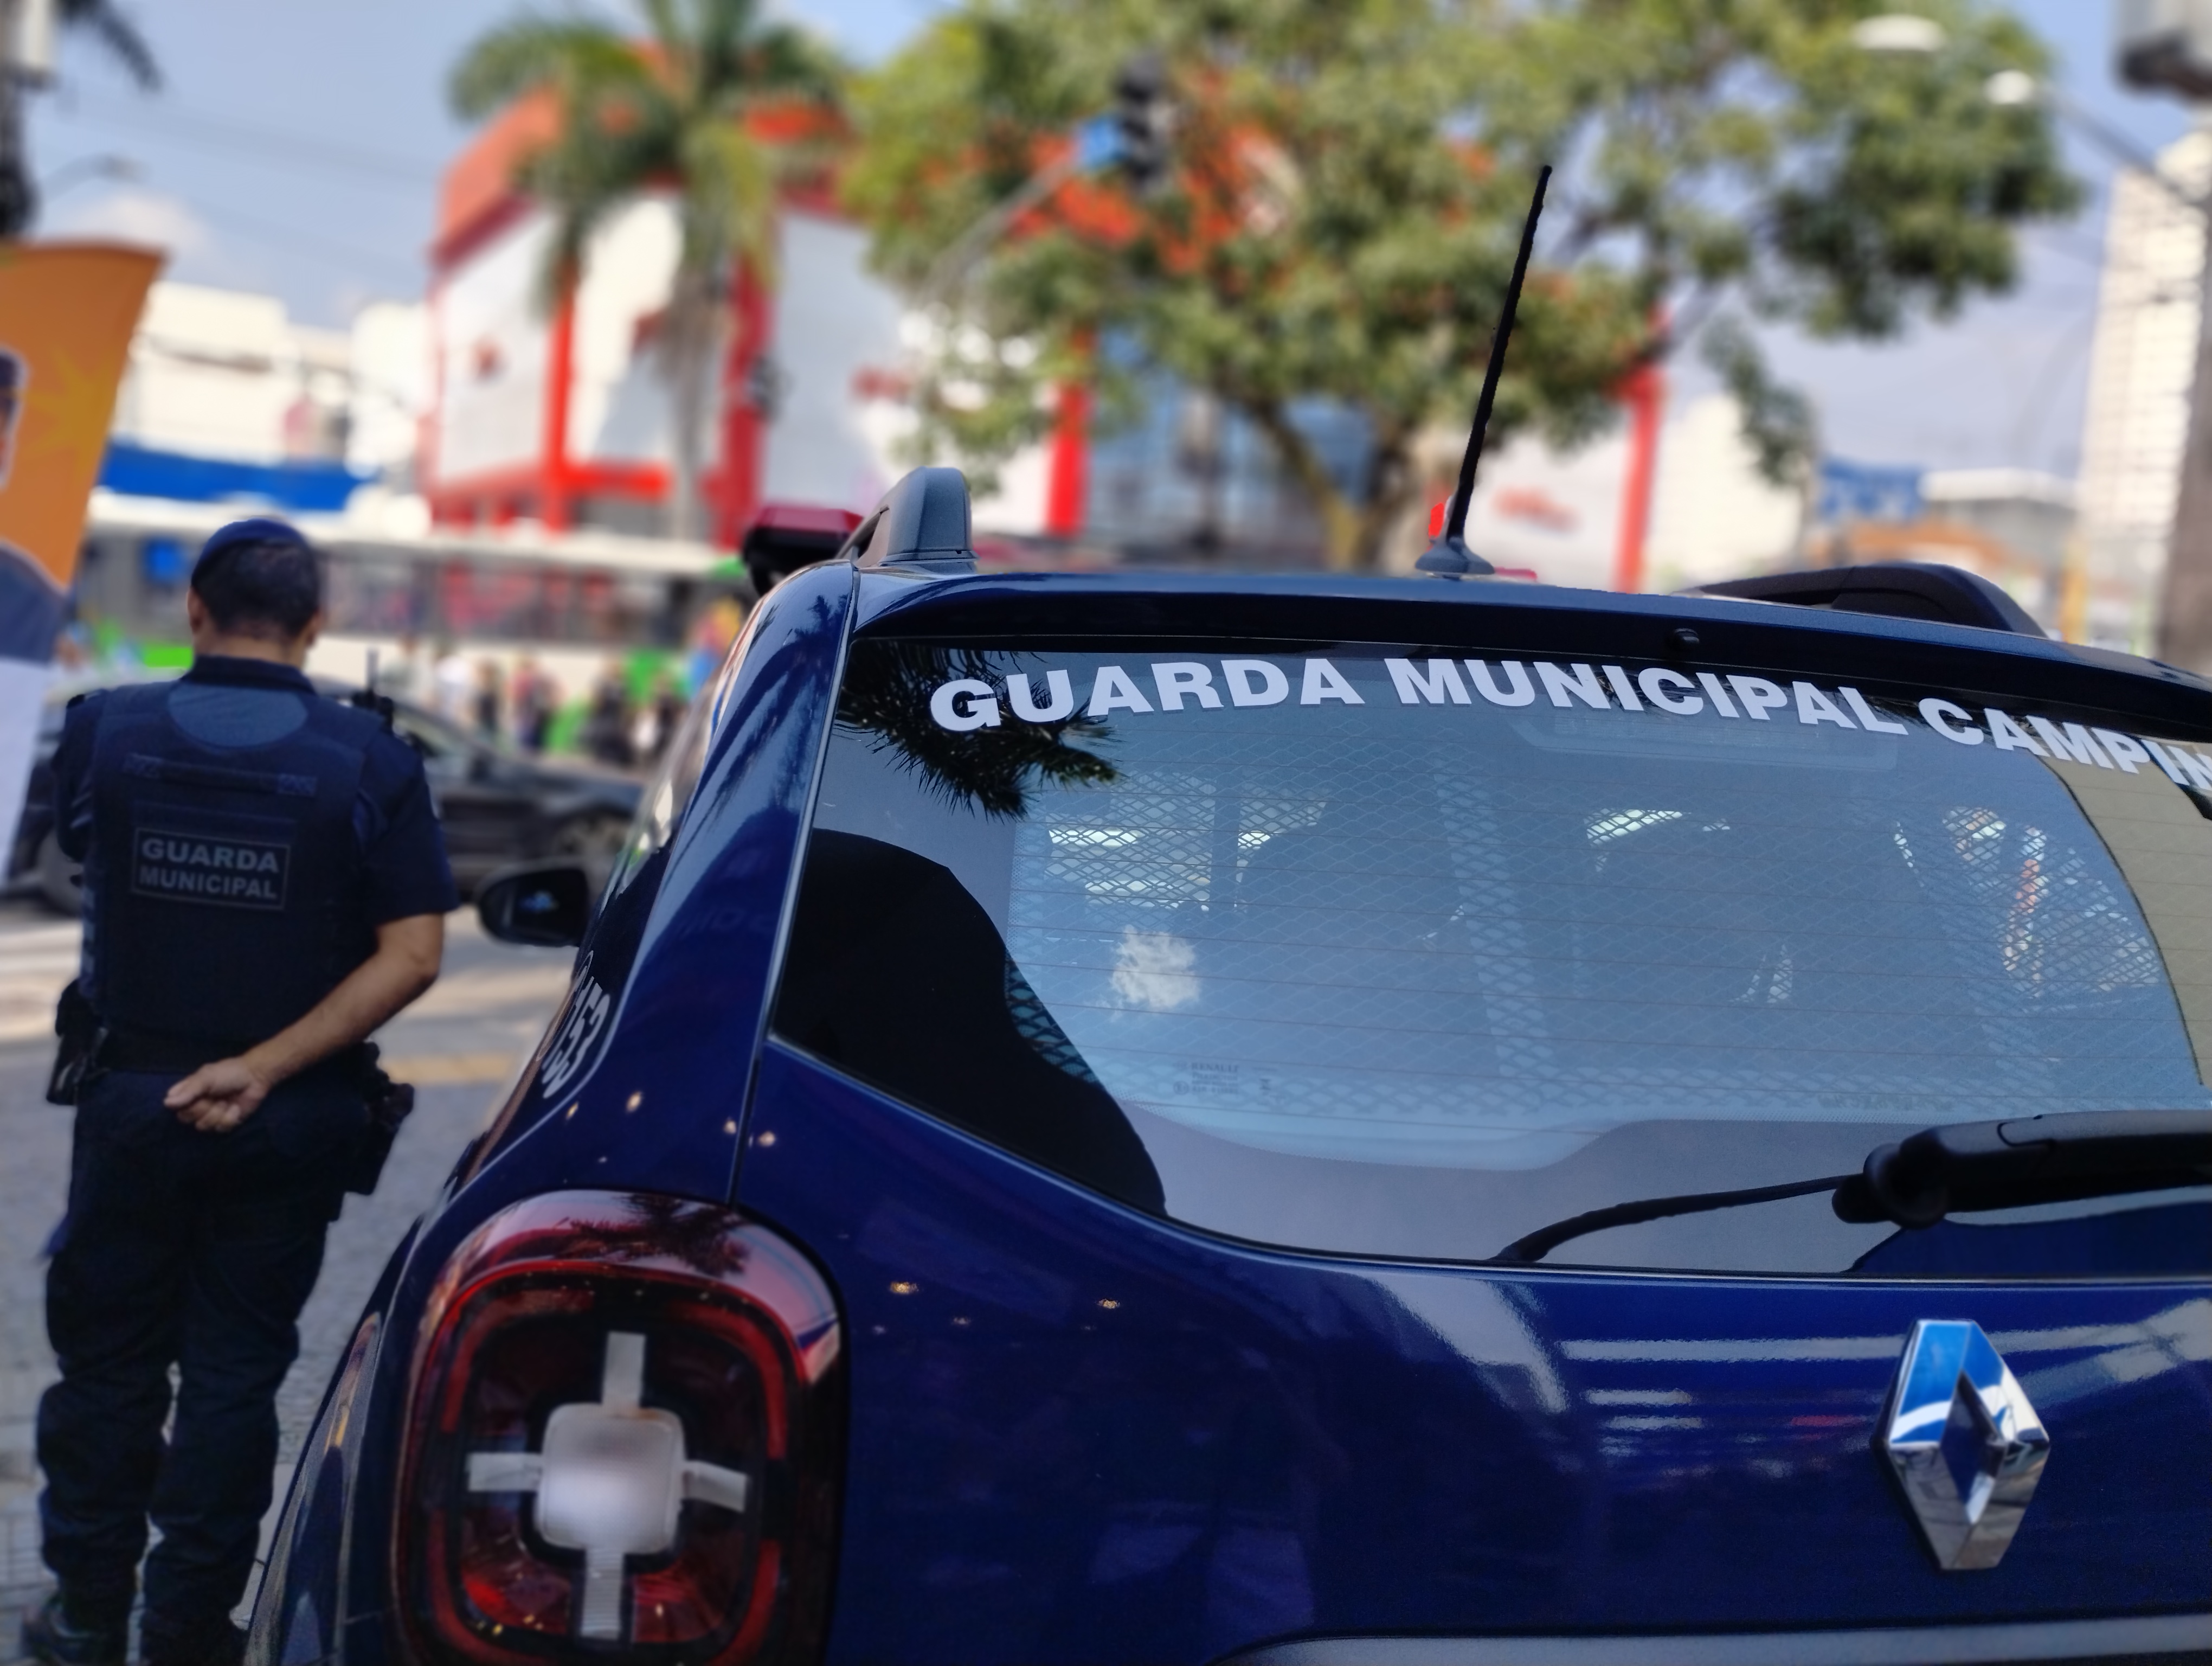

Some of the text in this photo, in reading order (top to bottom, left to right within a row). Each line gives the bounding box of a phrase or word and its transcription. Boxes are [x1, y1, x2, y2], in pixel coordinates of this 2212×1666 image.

[930, 658, 2212, 790] GUARDA MUNICIPAL CAMPIN
[139, 866, 277, 899] MUNICIPAL
[142, 838, 279, 873] GUARDA
[542, 976, 610, 1099] 153
